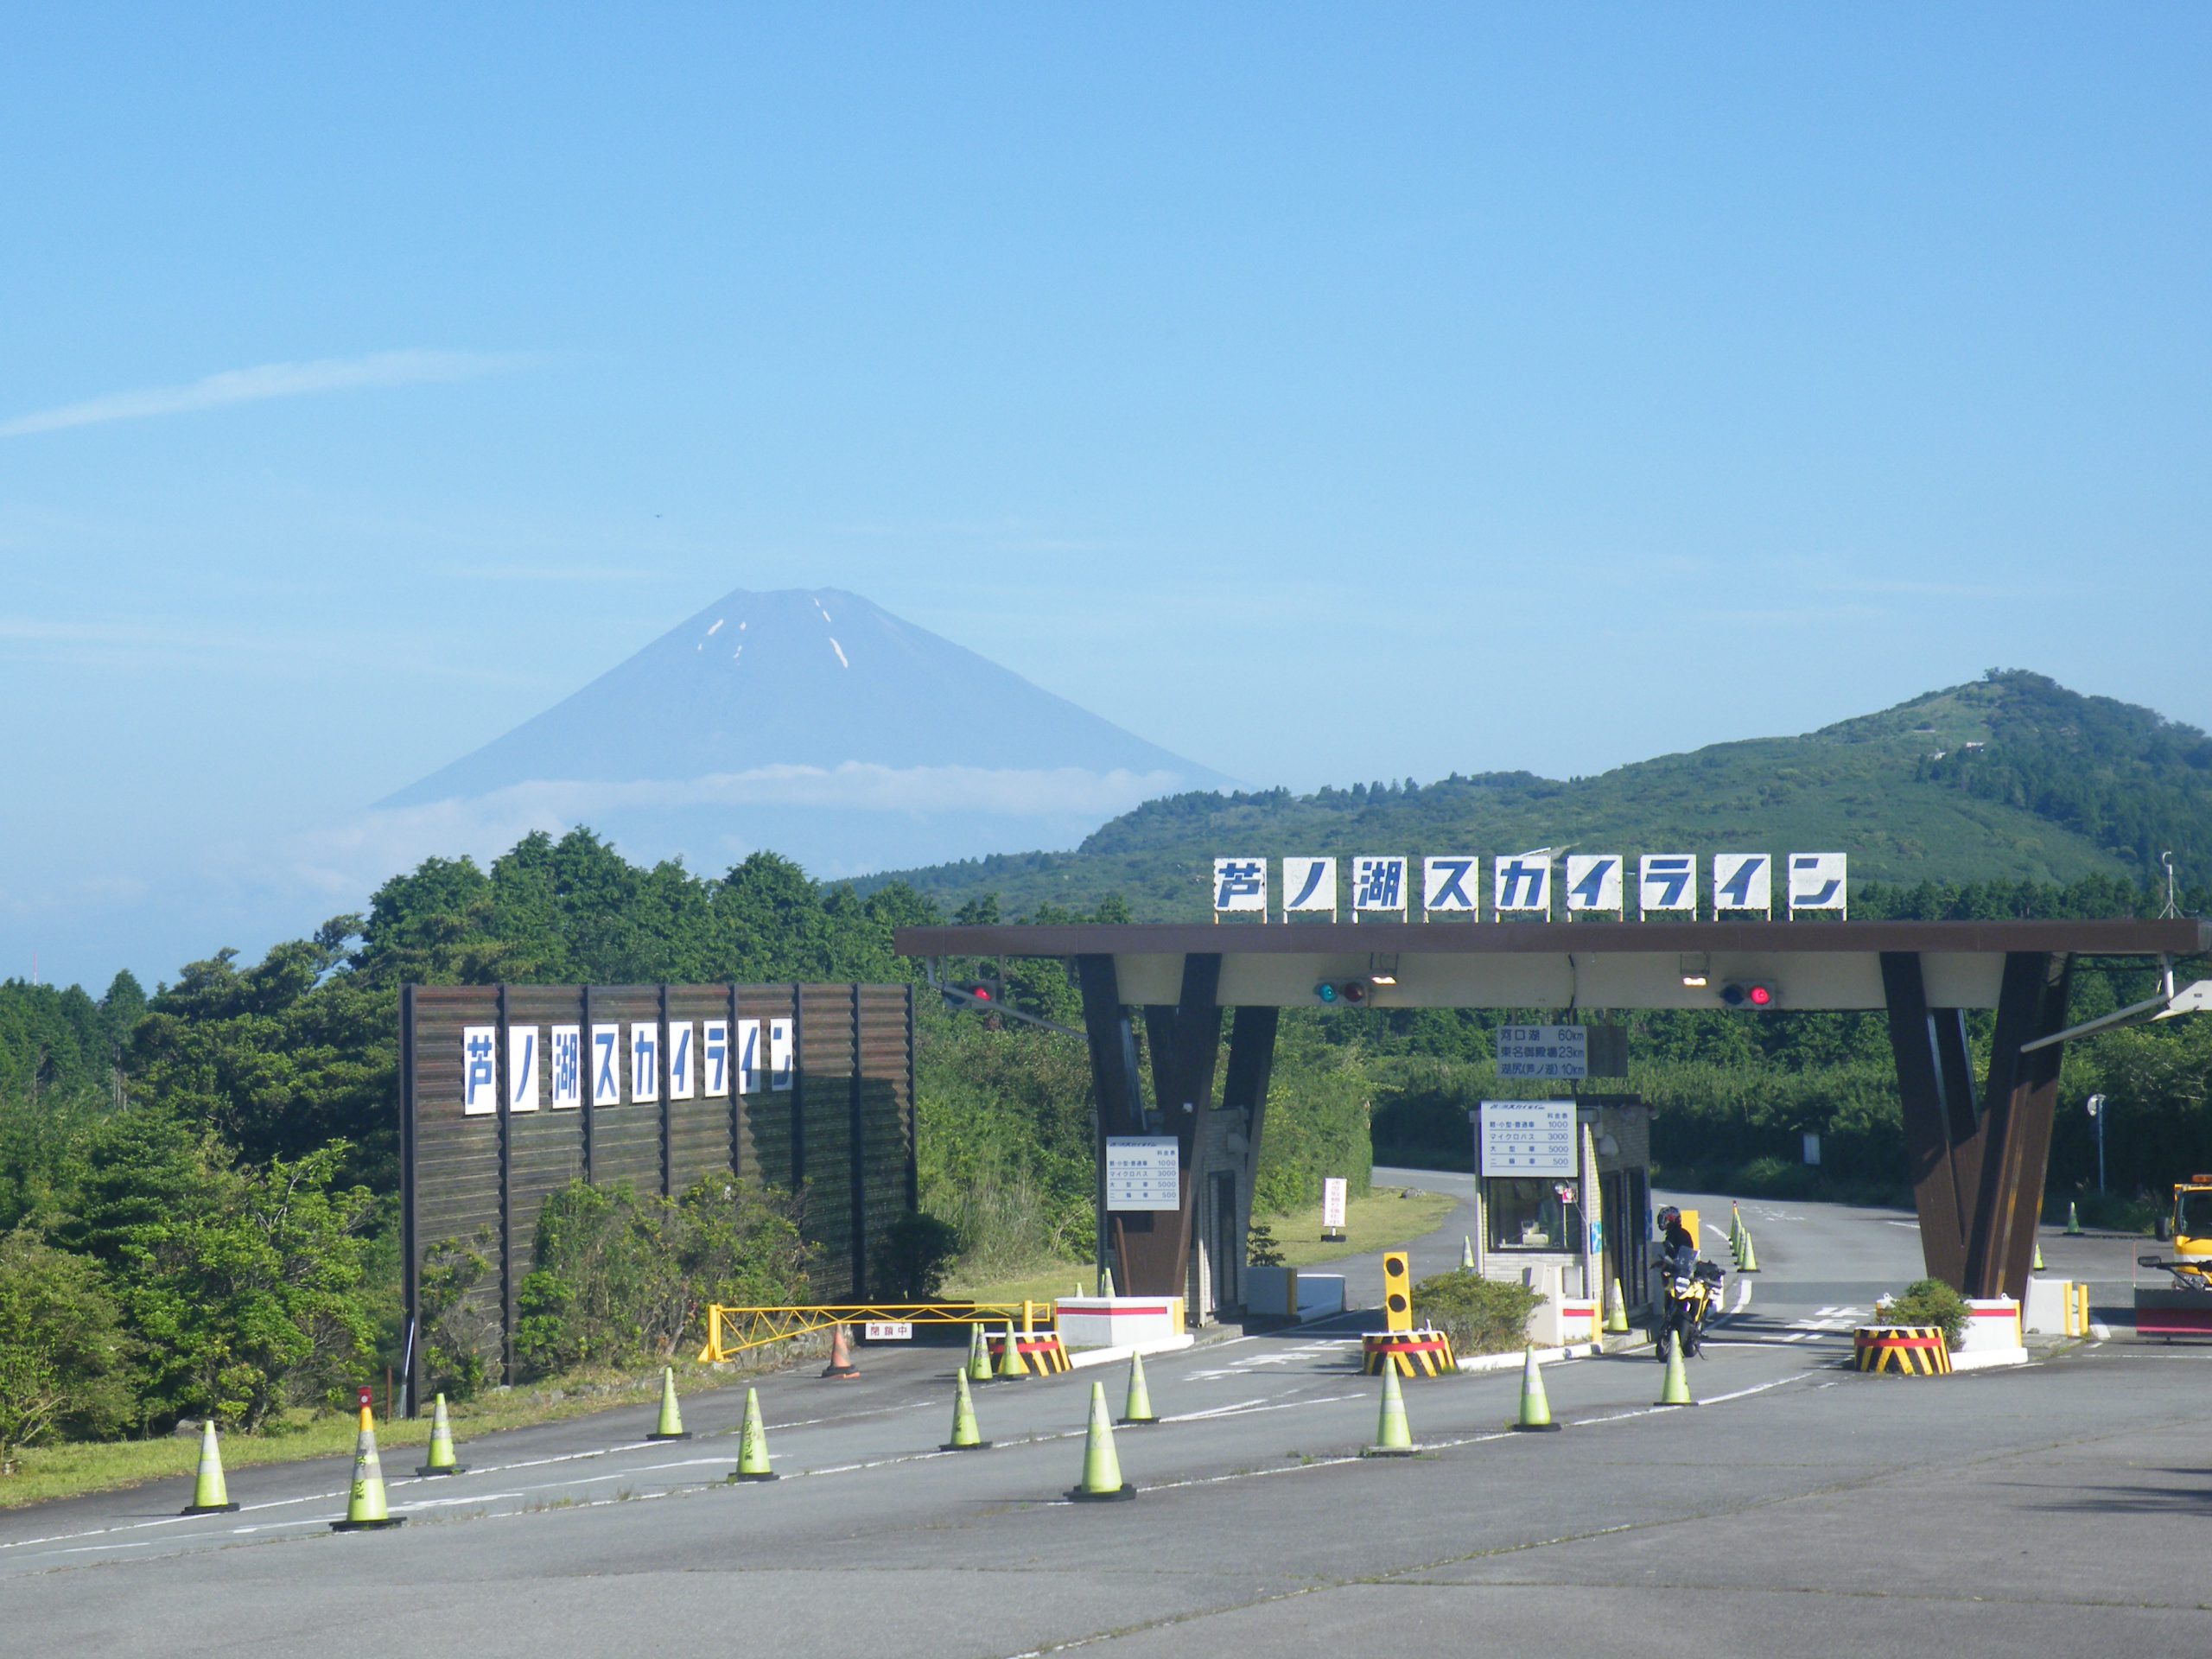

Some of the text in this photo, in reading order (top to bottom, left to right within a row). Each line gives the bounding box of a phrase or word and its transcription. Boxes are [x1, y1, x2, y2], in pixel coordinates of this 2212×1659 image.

[1217, 858, 1841, 907] 芦ノ湖スカイライン
[1500, 1028, 1585, 1041] 河口湖 60km
[1559, 1046, 1585, 1058] 23km
[467, 1027, 791, 1105] 芦ノ湖スカイライン
[1562, 1063, 1585, 1075] 10km
[870, 1325, 907, 1336] 閉鎖中
